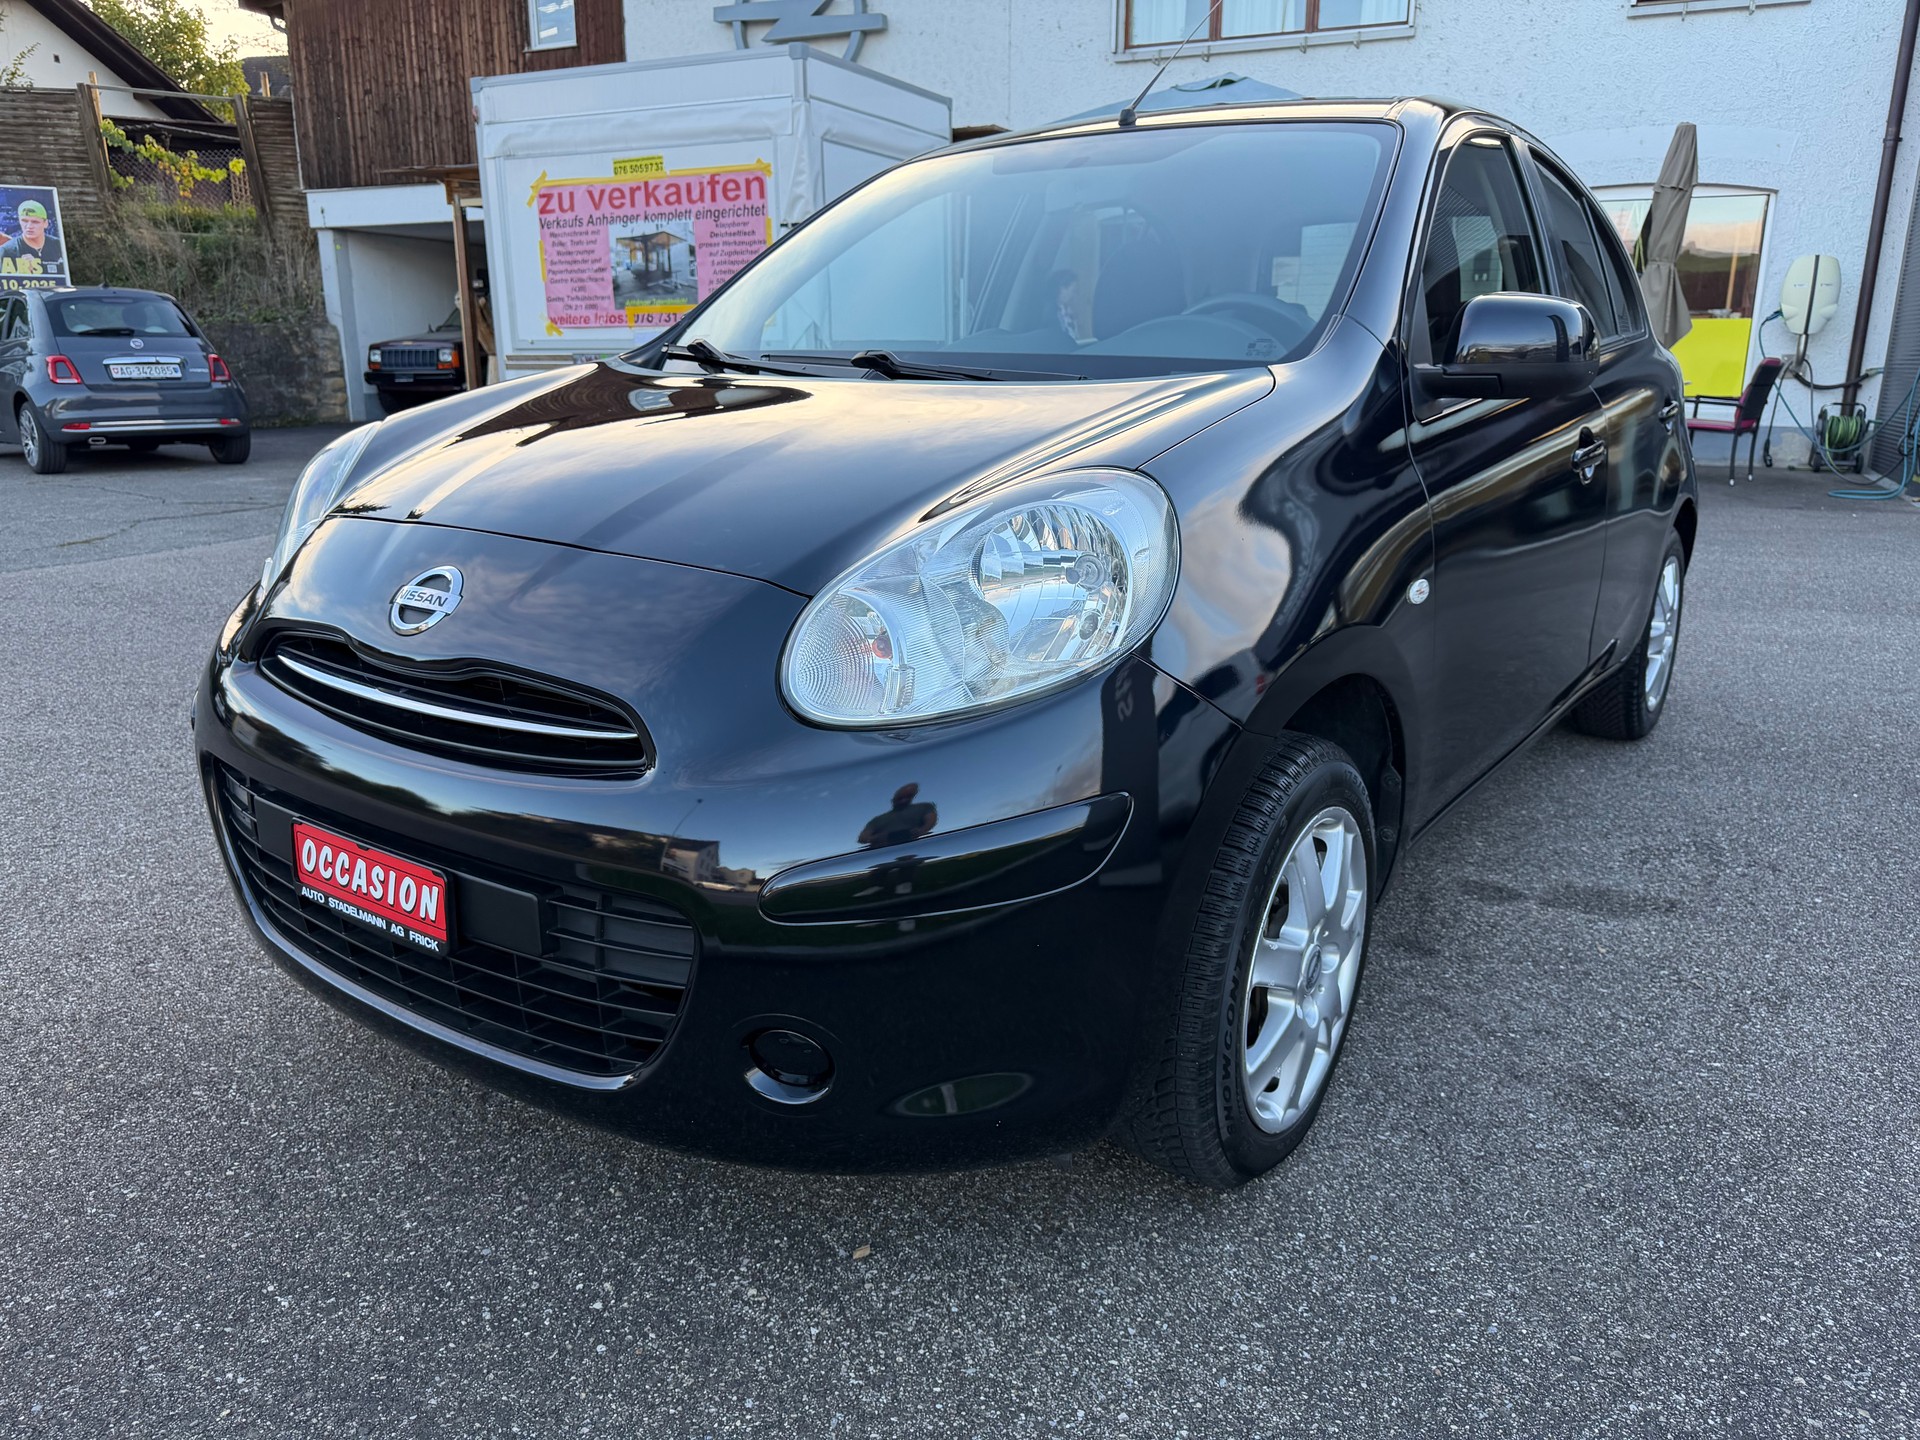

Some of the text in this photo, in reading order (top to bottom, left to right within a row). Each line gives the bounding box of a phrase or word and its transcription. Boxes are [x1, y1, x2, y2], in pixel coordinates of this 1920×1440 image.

[614, 166, 628, 175] 076
[538, 174, 766, 215] zu verkaufen
[540, 204, 766, 230] Verkaufs Anhänger komplett eingerichtet
[550, 314, 590, 325] weitere
[396, 588, 449, 608] NISSAN
[302, 838, 440, 922] OCCASION
[301, 886, 440, 952] AUTO STADELMANN AG FRICK
